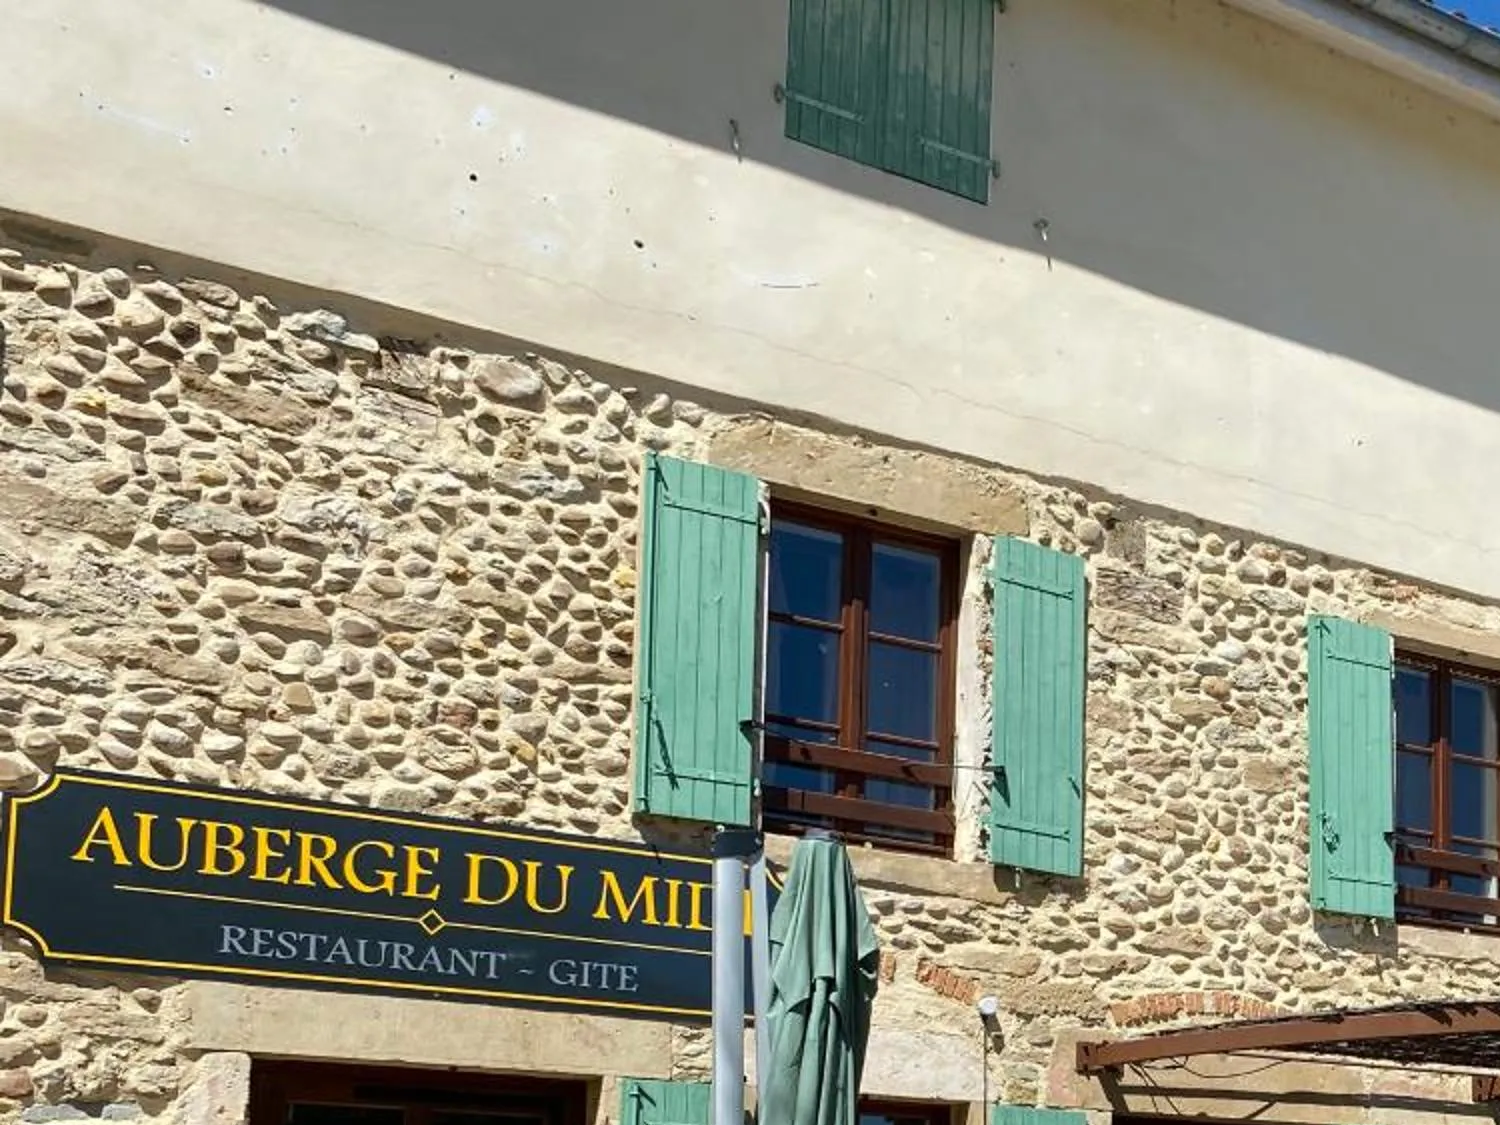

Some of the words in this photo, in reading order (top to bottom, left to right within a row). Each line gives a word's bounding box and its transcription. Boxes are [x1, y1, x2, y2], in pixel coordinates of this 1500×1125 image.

[70, 806, 440, 901] AUBERGE
[463, 852, 576, 914] DU
[219, 924, 507, 979] RESTAURANT
[548, 958, 640, 993] GITE
